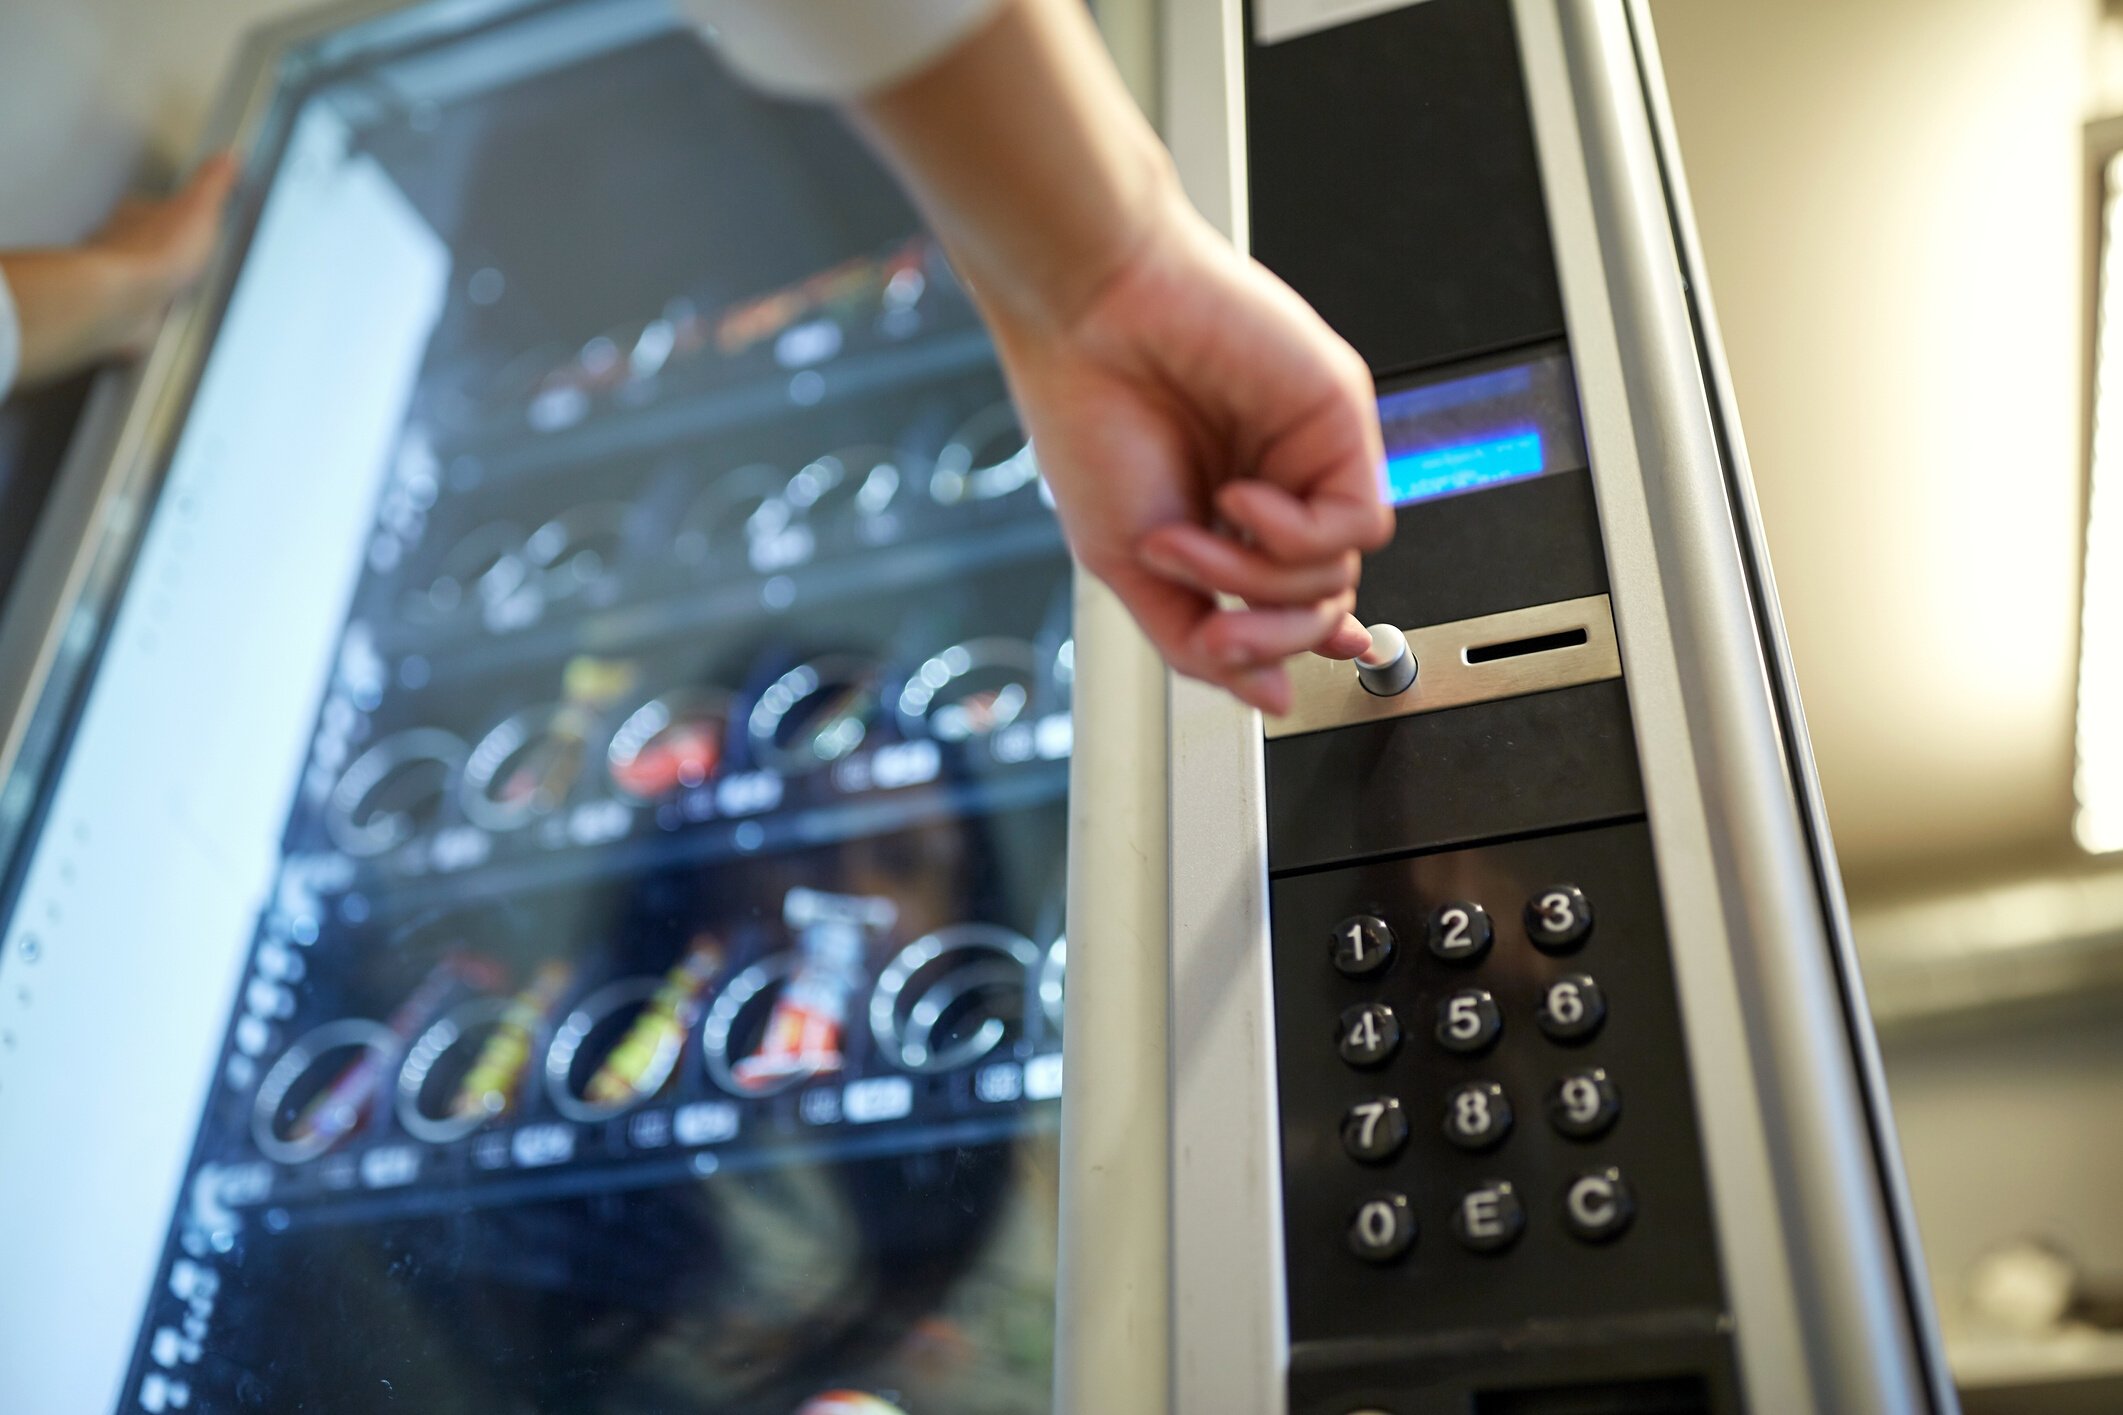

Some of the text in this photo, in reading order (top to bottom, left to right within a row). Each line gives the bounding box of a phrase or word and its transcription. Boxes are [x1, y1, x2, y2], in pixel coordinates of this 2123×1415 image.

[1346, 892, 1574, 962] 1 2 3
[1349, 982, 1584, 1052] 4 5 6
[1353, 1079, 1600, 1147] 7 8 9
[1359, 1177, 1614, 1246] 0 E C
